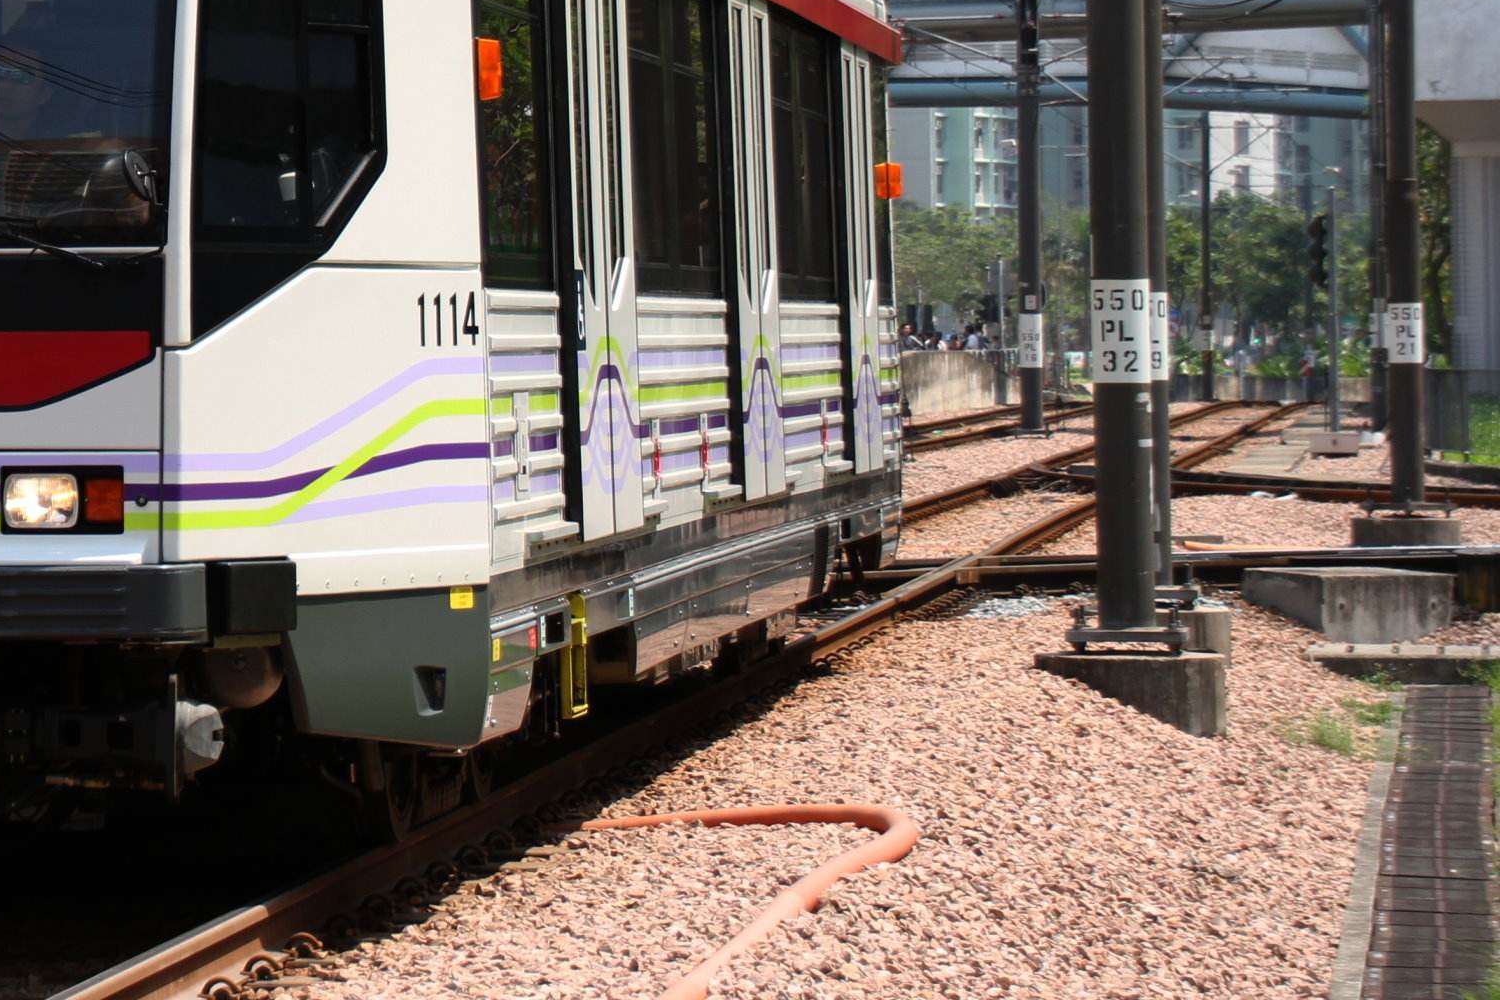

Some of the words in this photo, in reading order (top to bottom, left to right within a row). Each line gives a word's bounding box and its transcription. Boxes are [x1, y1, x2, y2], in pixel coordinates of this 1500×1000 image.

[1093, 288, 1144, 311] 550
[417, 290, 479, 346] 1114
[1390, 306, 1420, 320] 550
[1101, 319, 1134, 342] PL
[1395, 325, 1416, 338] PL
[1395, 342, 1414, 355] 21
[1102, 350, 1139, 372] 32
